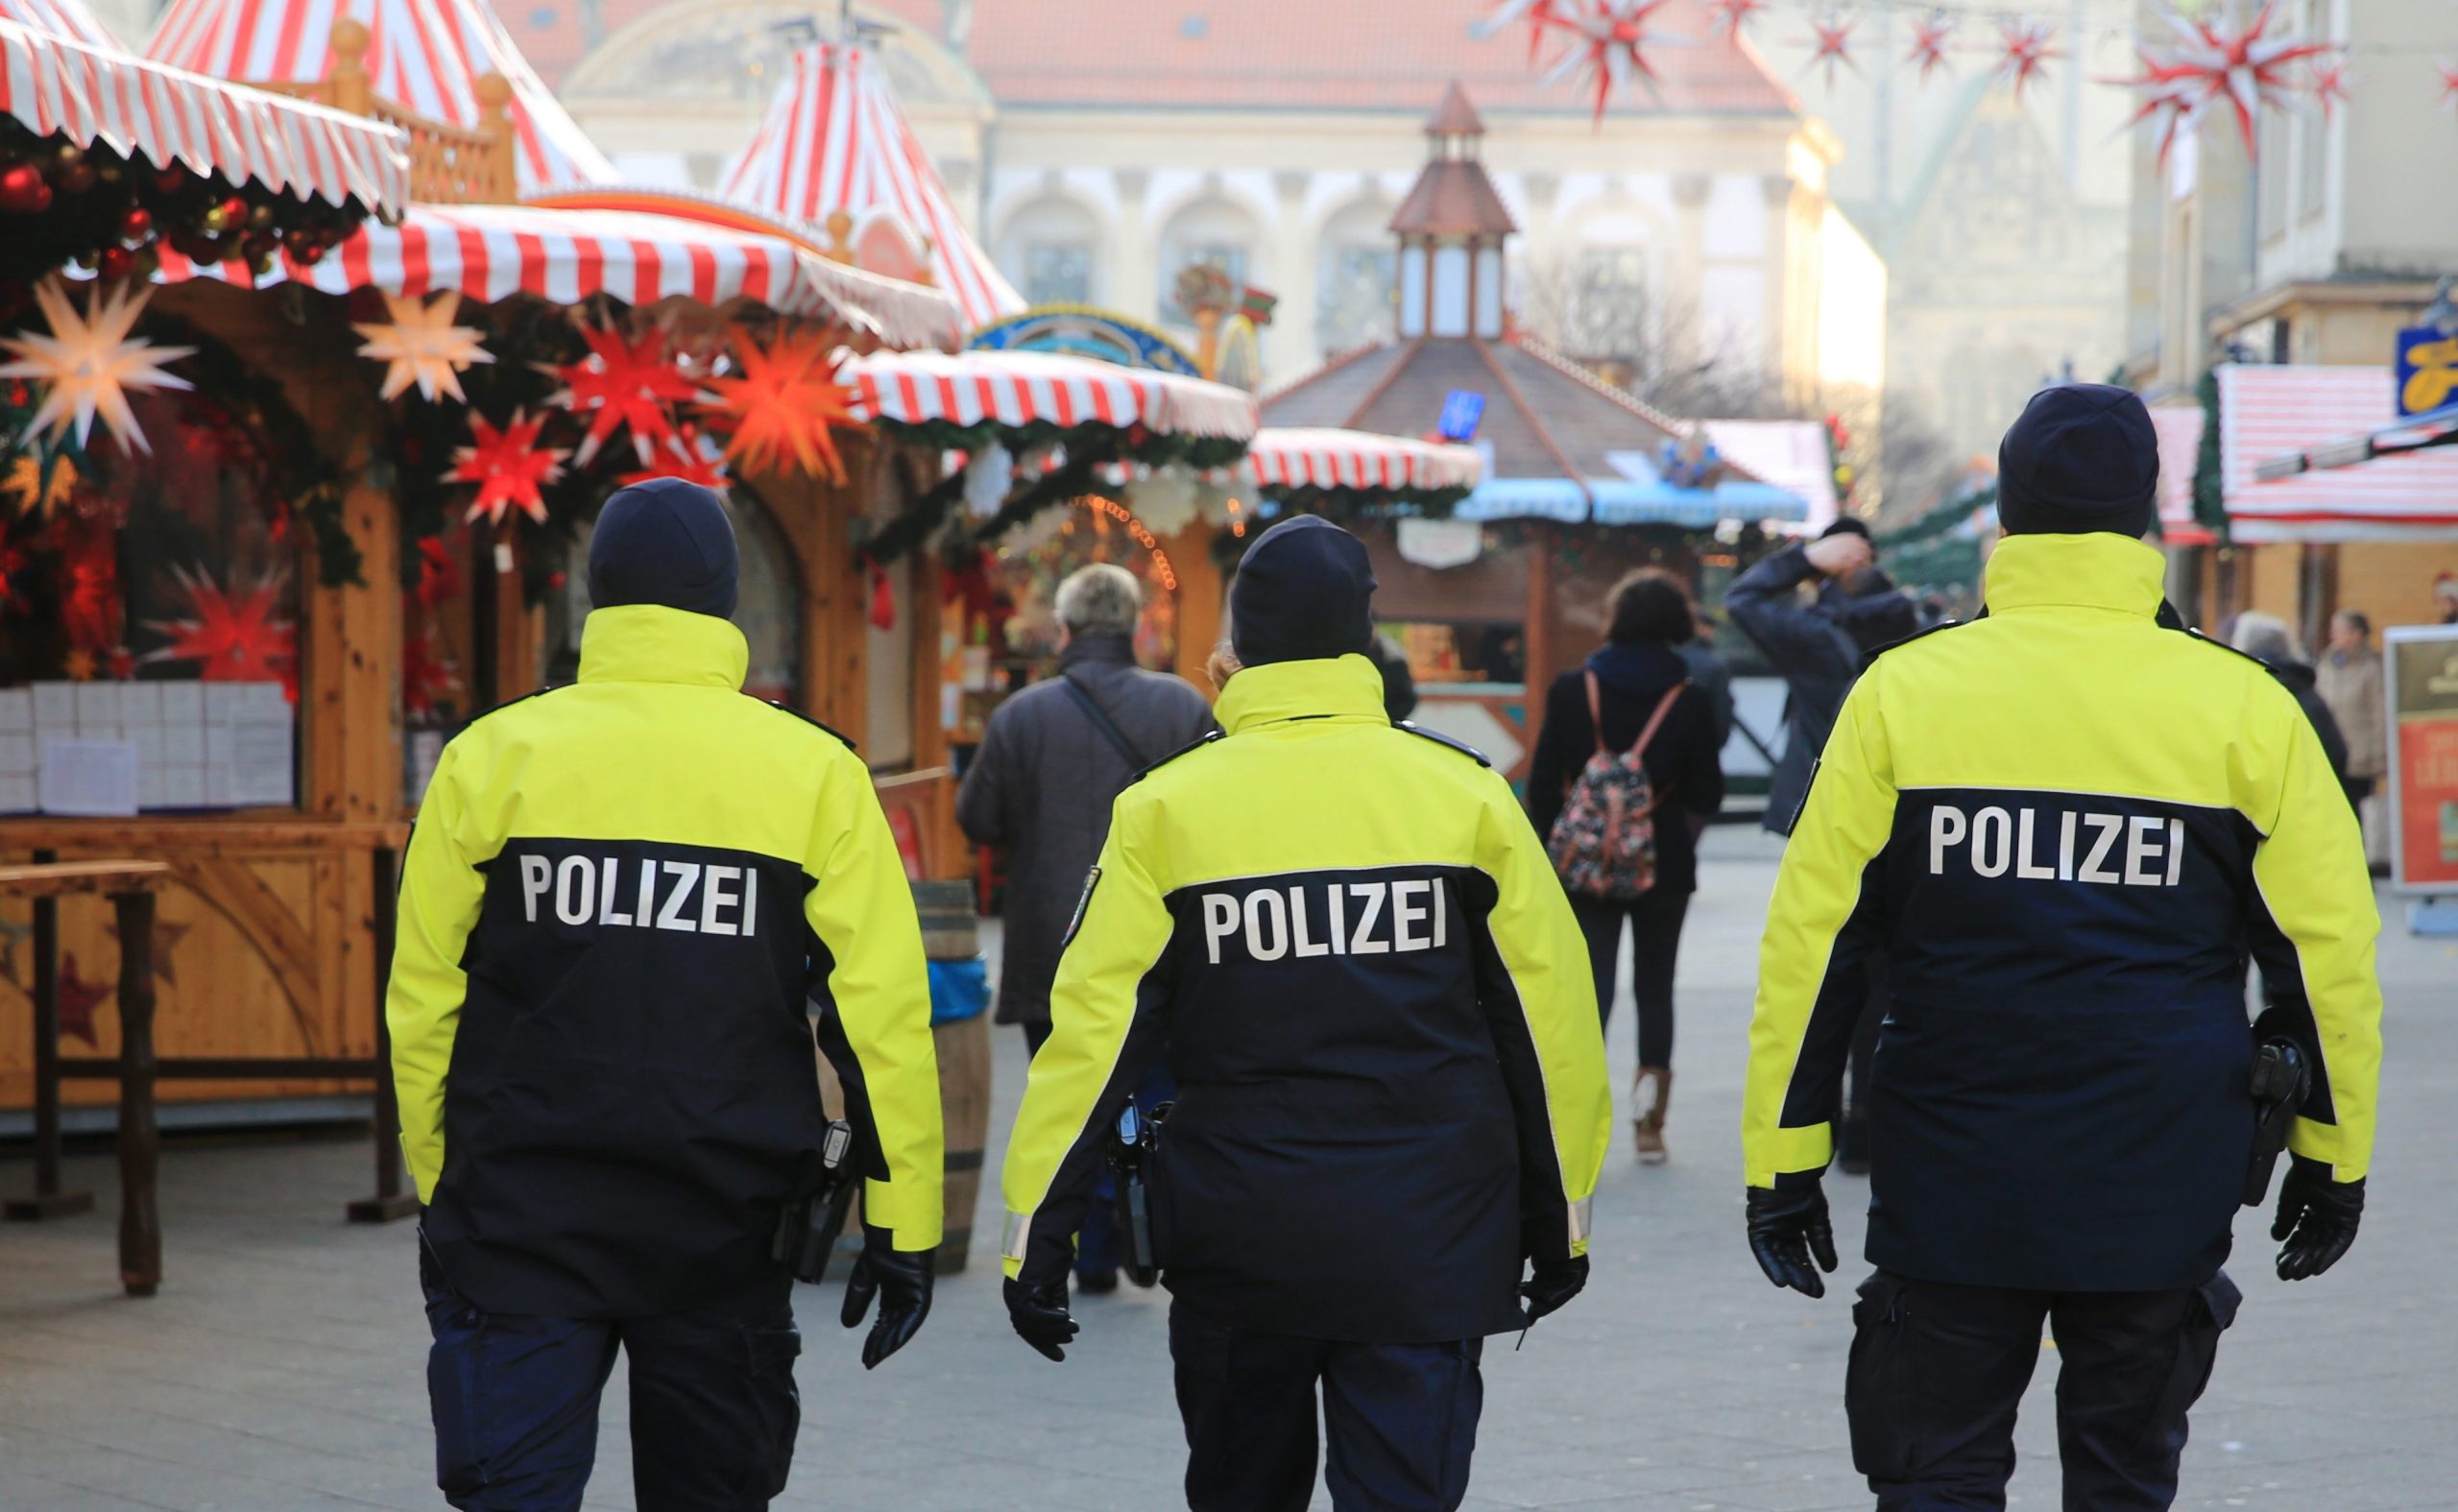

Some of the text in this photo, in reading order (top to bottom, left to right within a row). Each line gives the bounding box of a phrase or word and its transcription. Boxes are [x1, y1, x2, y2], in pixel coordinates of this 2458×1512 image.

[1929, 804, 2184, 886] POLIZEI
[519, 854, 758, 937] POLIZEI
[1201, 876, 1446, 965] POLIZEI
